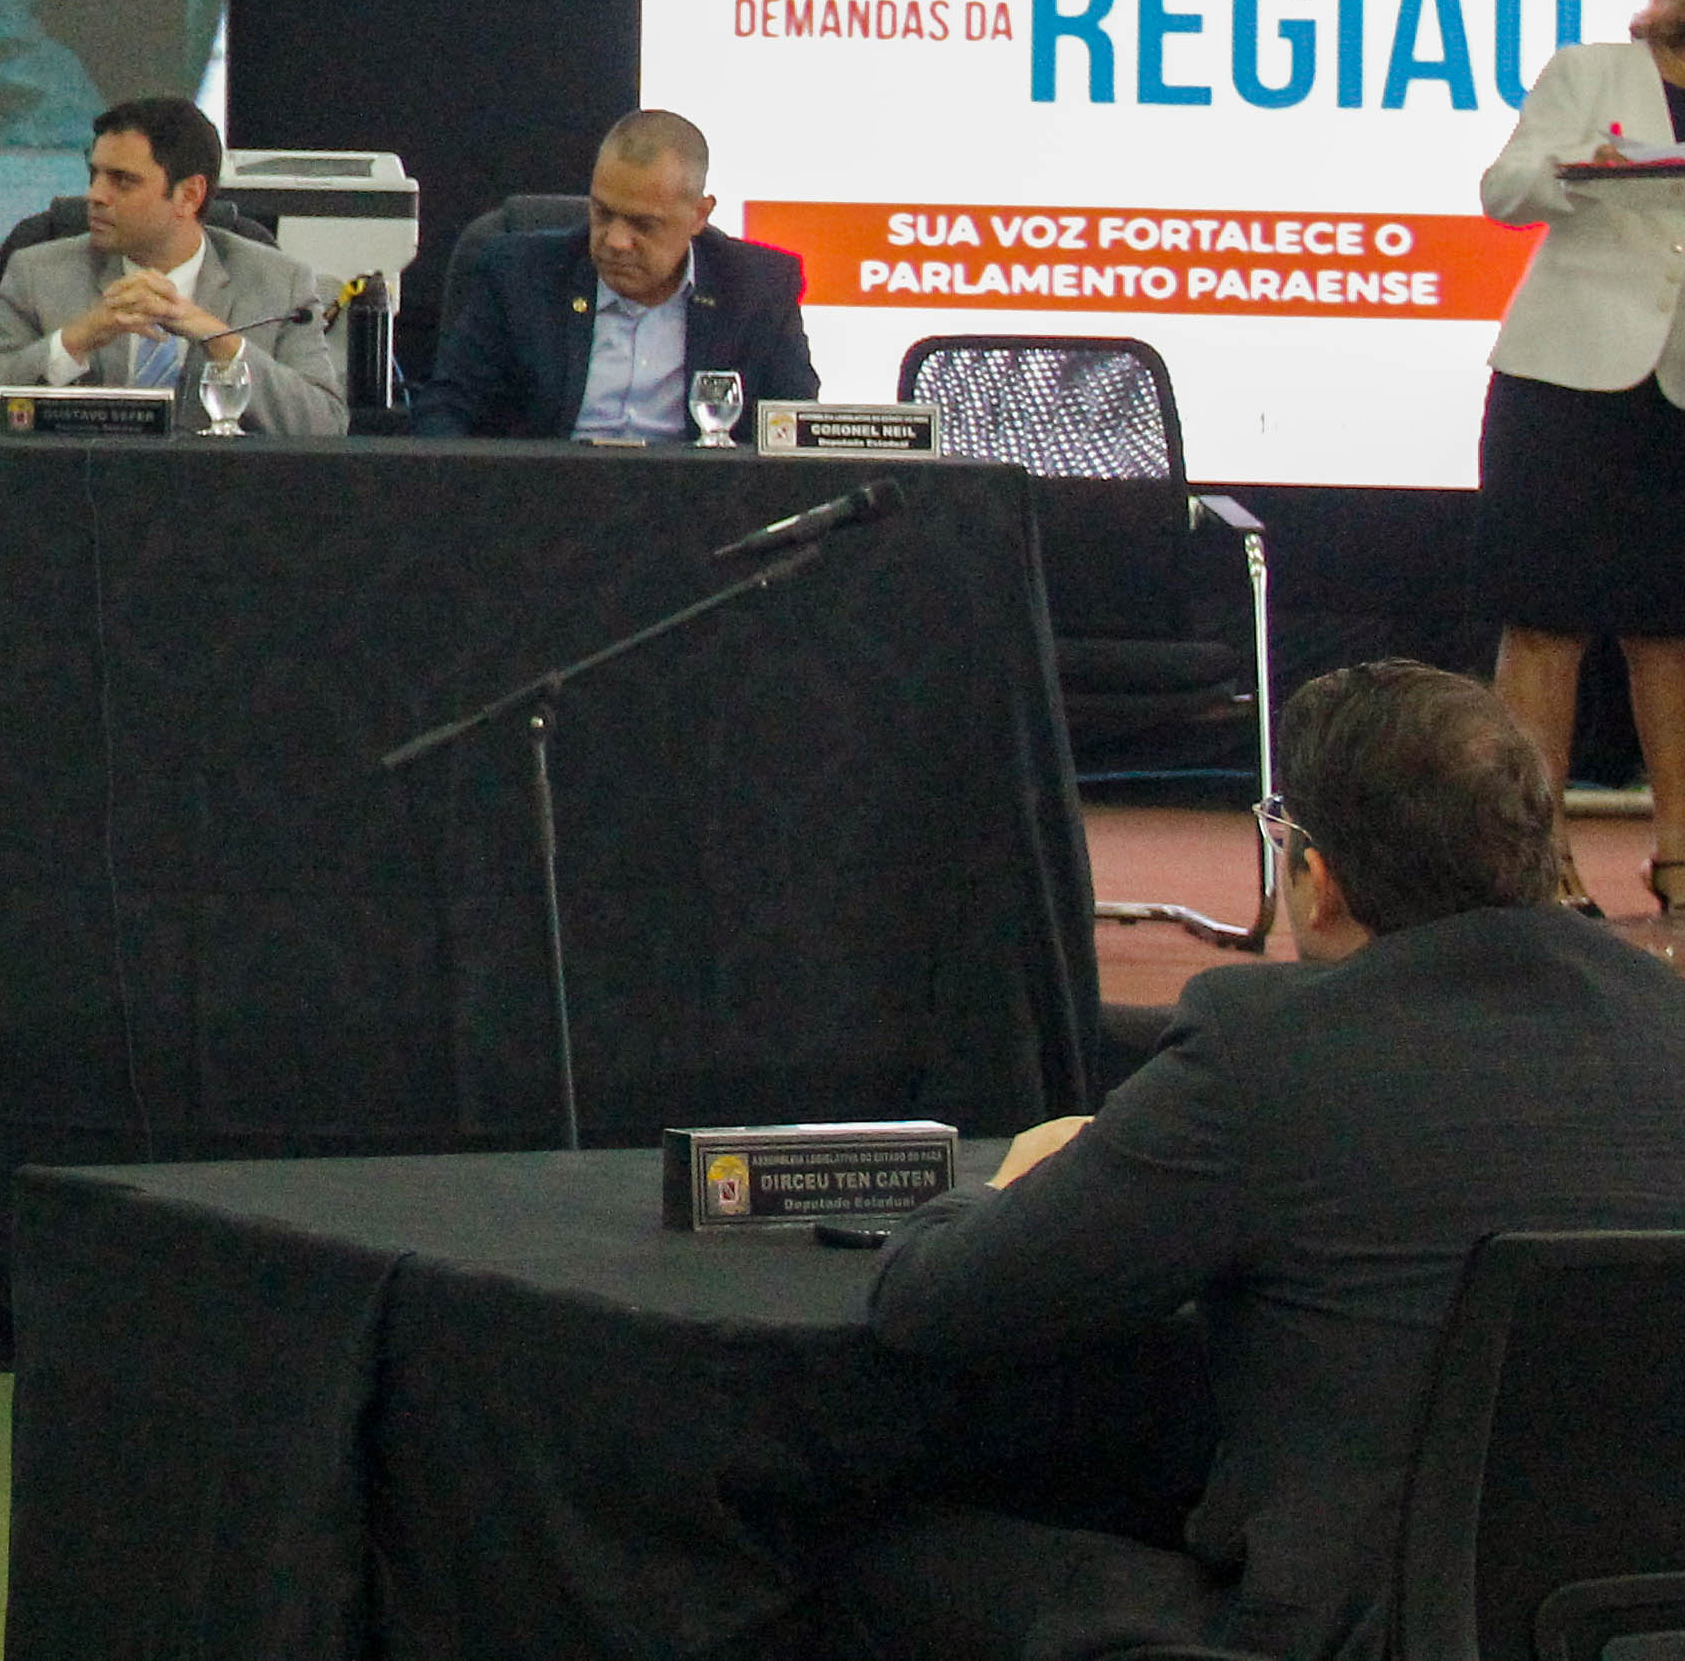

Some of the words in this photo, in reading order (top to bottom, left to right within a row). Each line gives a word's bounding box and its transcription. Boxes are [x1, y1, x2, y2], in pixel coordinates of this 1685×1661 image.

[965, 2, 1013, 42] DA
[887, 213, 981, 247] SUA
[990, 216, 1088, 249] VOZ
[1097, 217, 1366, 256] FORTALECE
[1374, 224, 1414, 257] O
[859, 259, 1178, 300] PARLAMENTO
[1187, 267, 1441, 306] PARAENSE
[810, 423, 880, 437] CORONEL
[881, 425, 917, 438] NEIL
[760, 1172, 829, 1192] DIRCEU
[834, 1171, 871, 1190] TEN
[875, 1169, 936, 1188] CATEN
